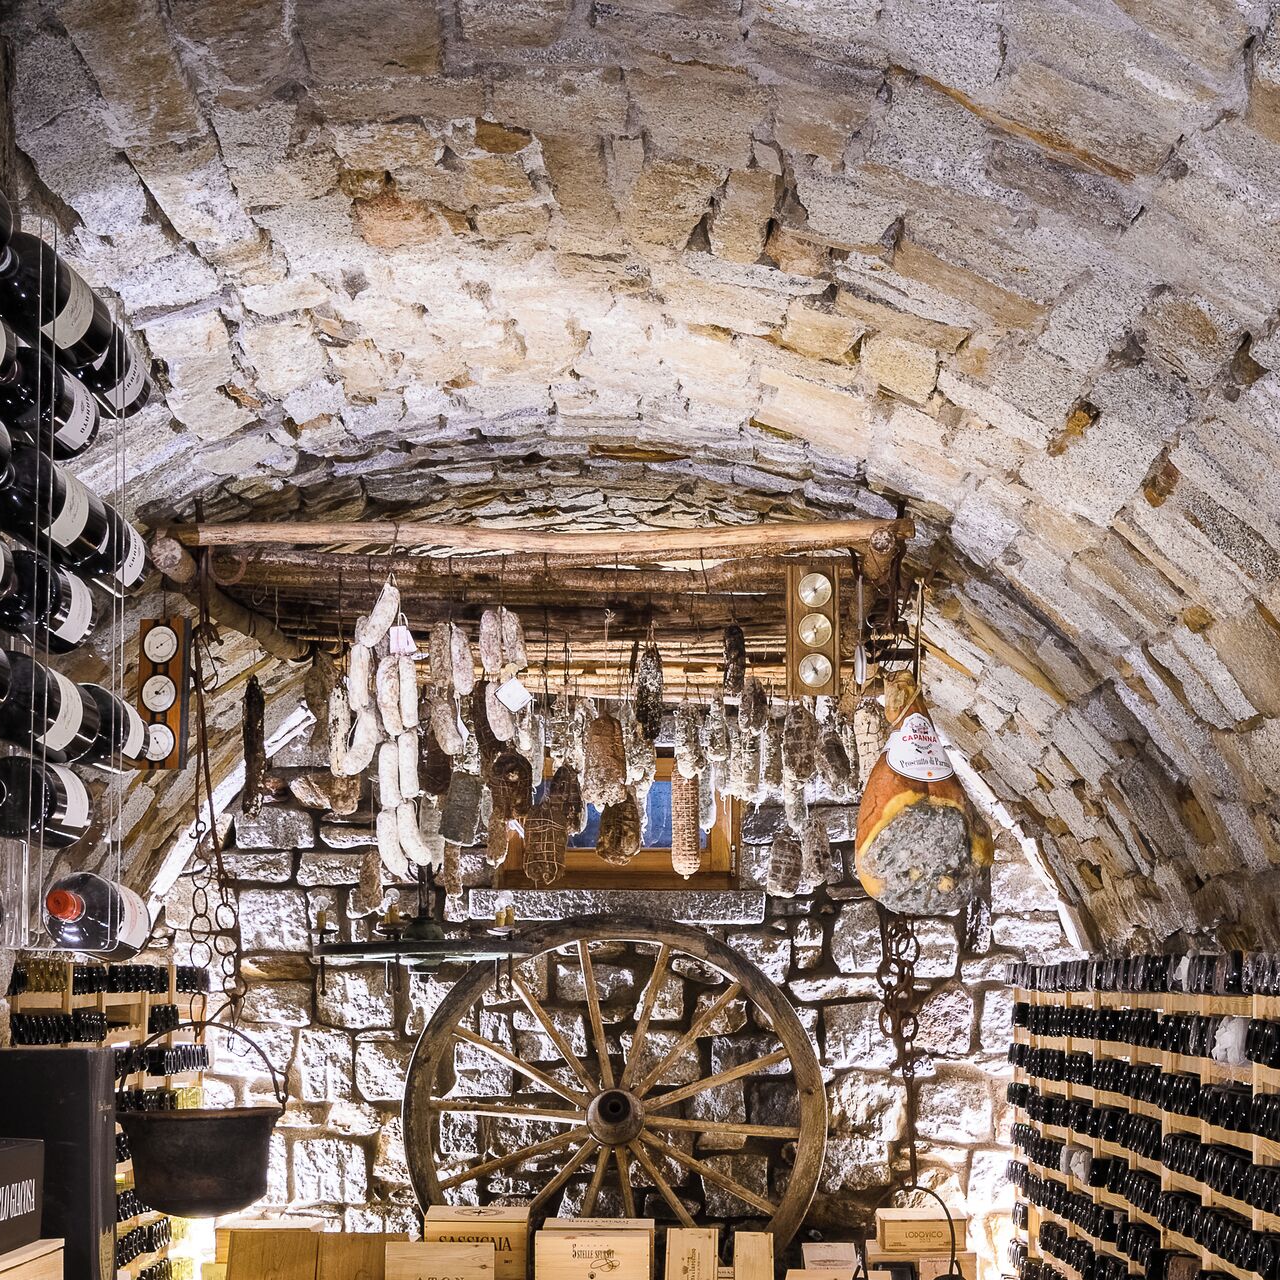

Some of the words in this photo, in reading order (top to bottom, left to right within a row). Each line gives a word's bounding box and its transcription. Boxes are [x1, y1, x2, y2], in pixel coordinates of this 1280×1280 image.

[902, 735, 937, 743] CAPANNA
[10, 1179, 36, 1218] GIACOSA
[577, 1249, 593, 1259] STELLE
